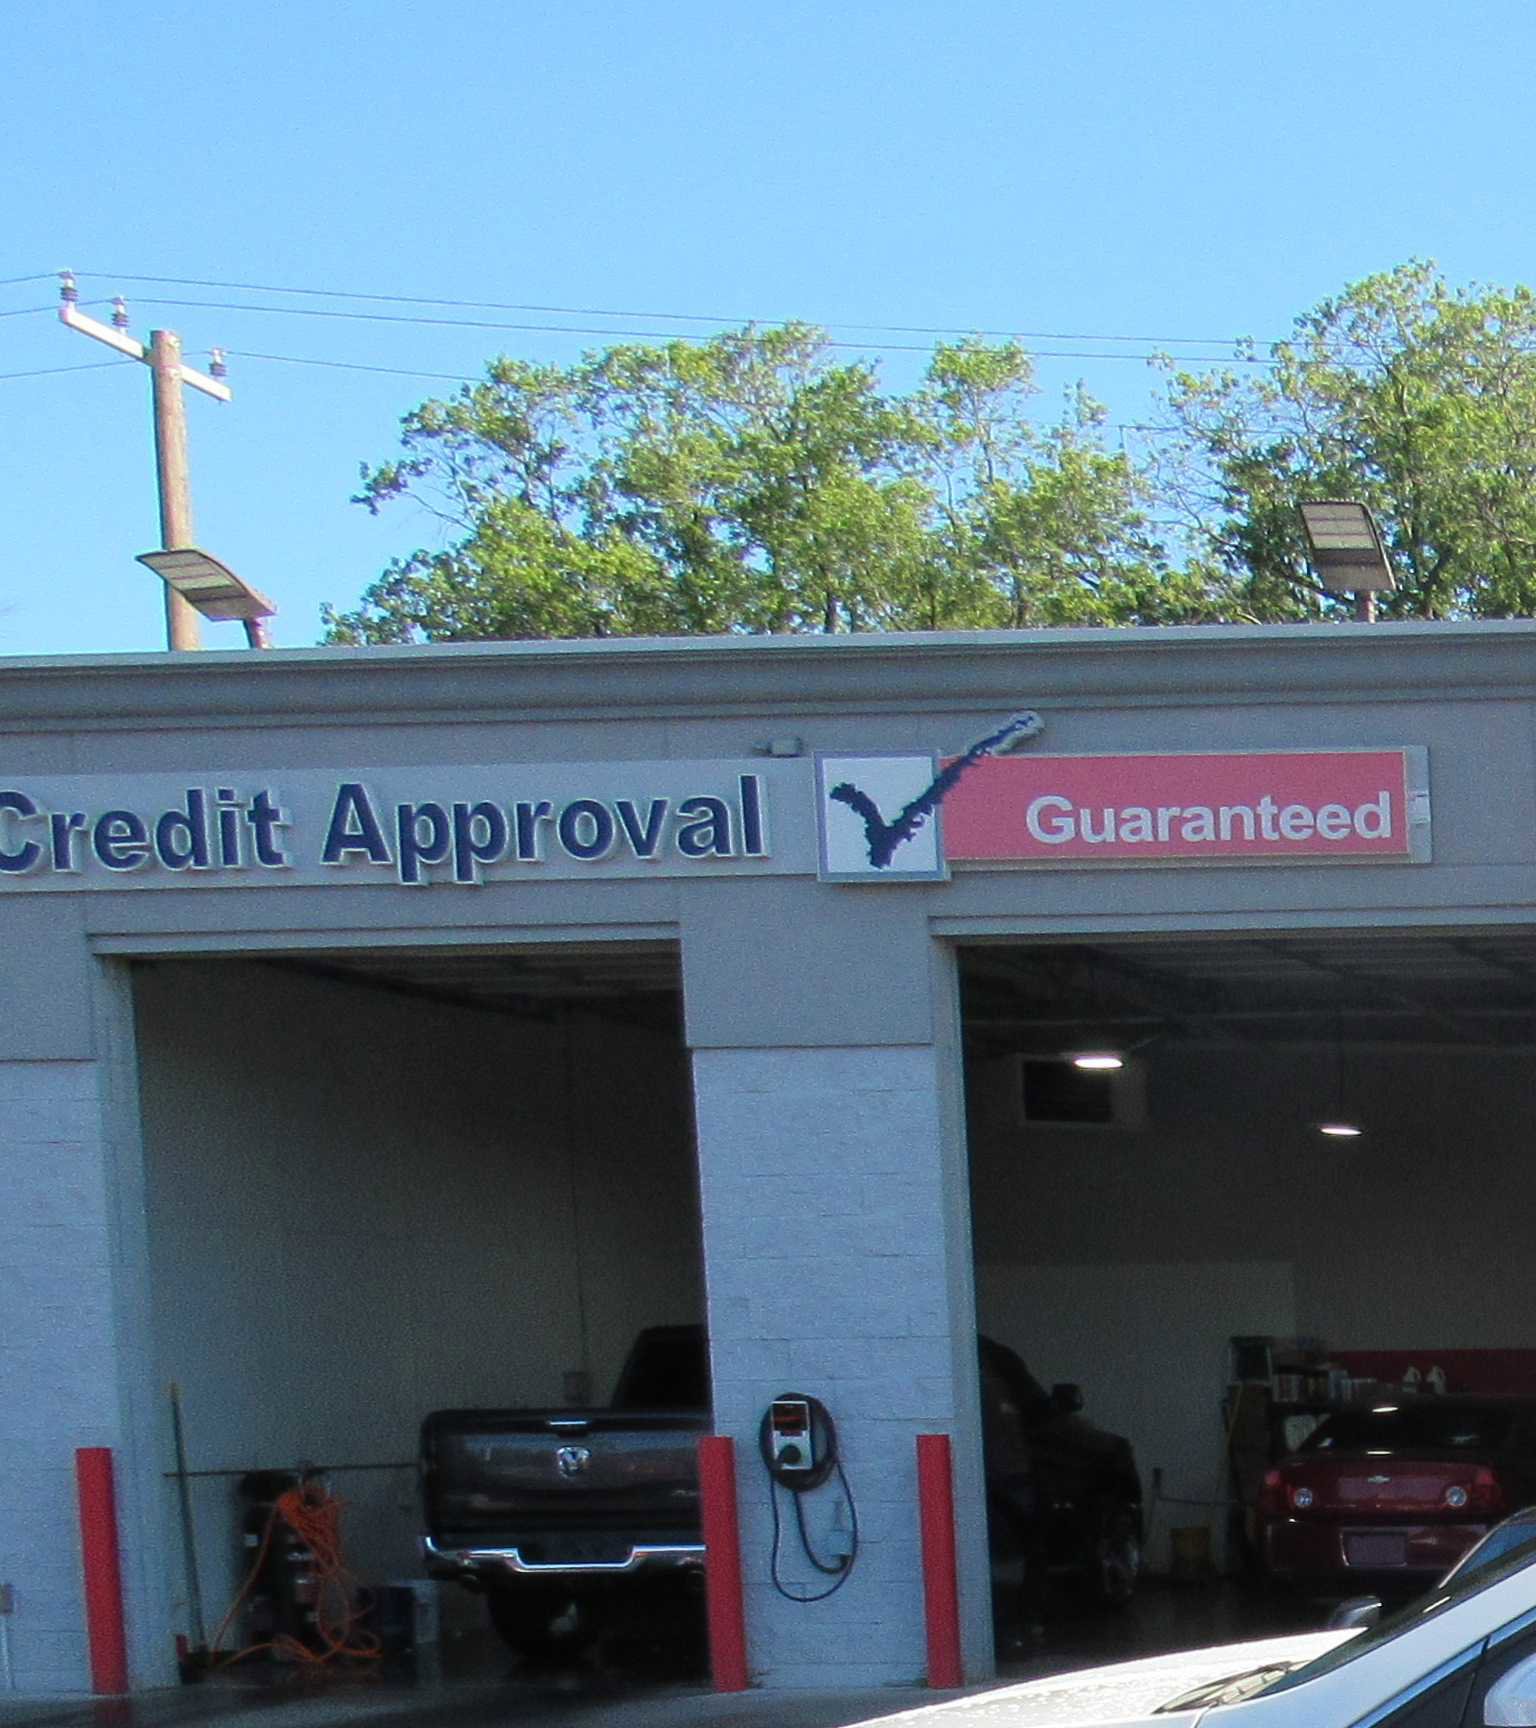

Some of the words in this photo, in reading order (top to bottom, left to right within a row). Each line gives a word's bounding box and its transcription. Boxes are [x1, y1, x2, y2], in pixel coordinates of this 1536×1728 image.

[0, 786, 293, 874] Credit
[320, 773, 771, 885] Approval
[1025, 790, 1393, 846] Guaranteed
